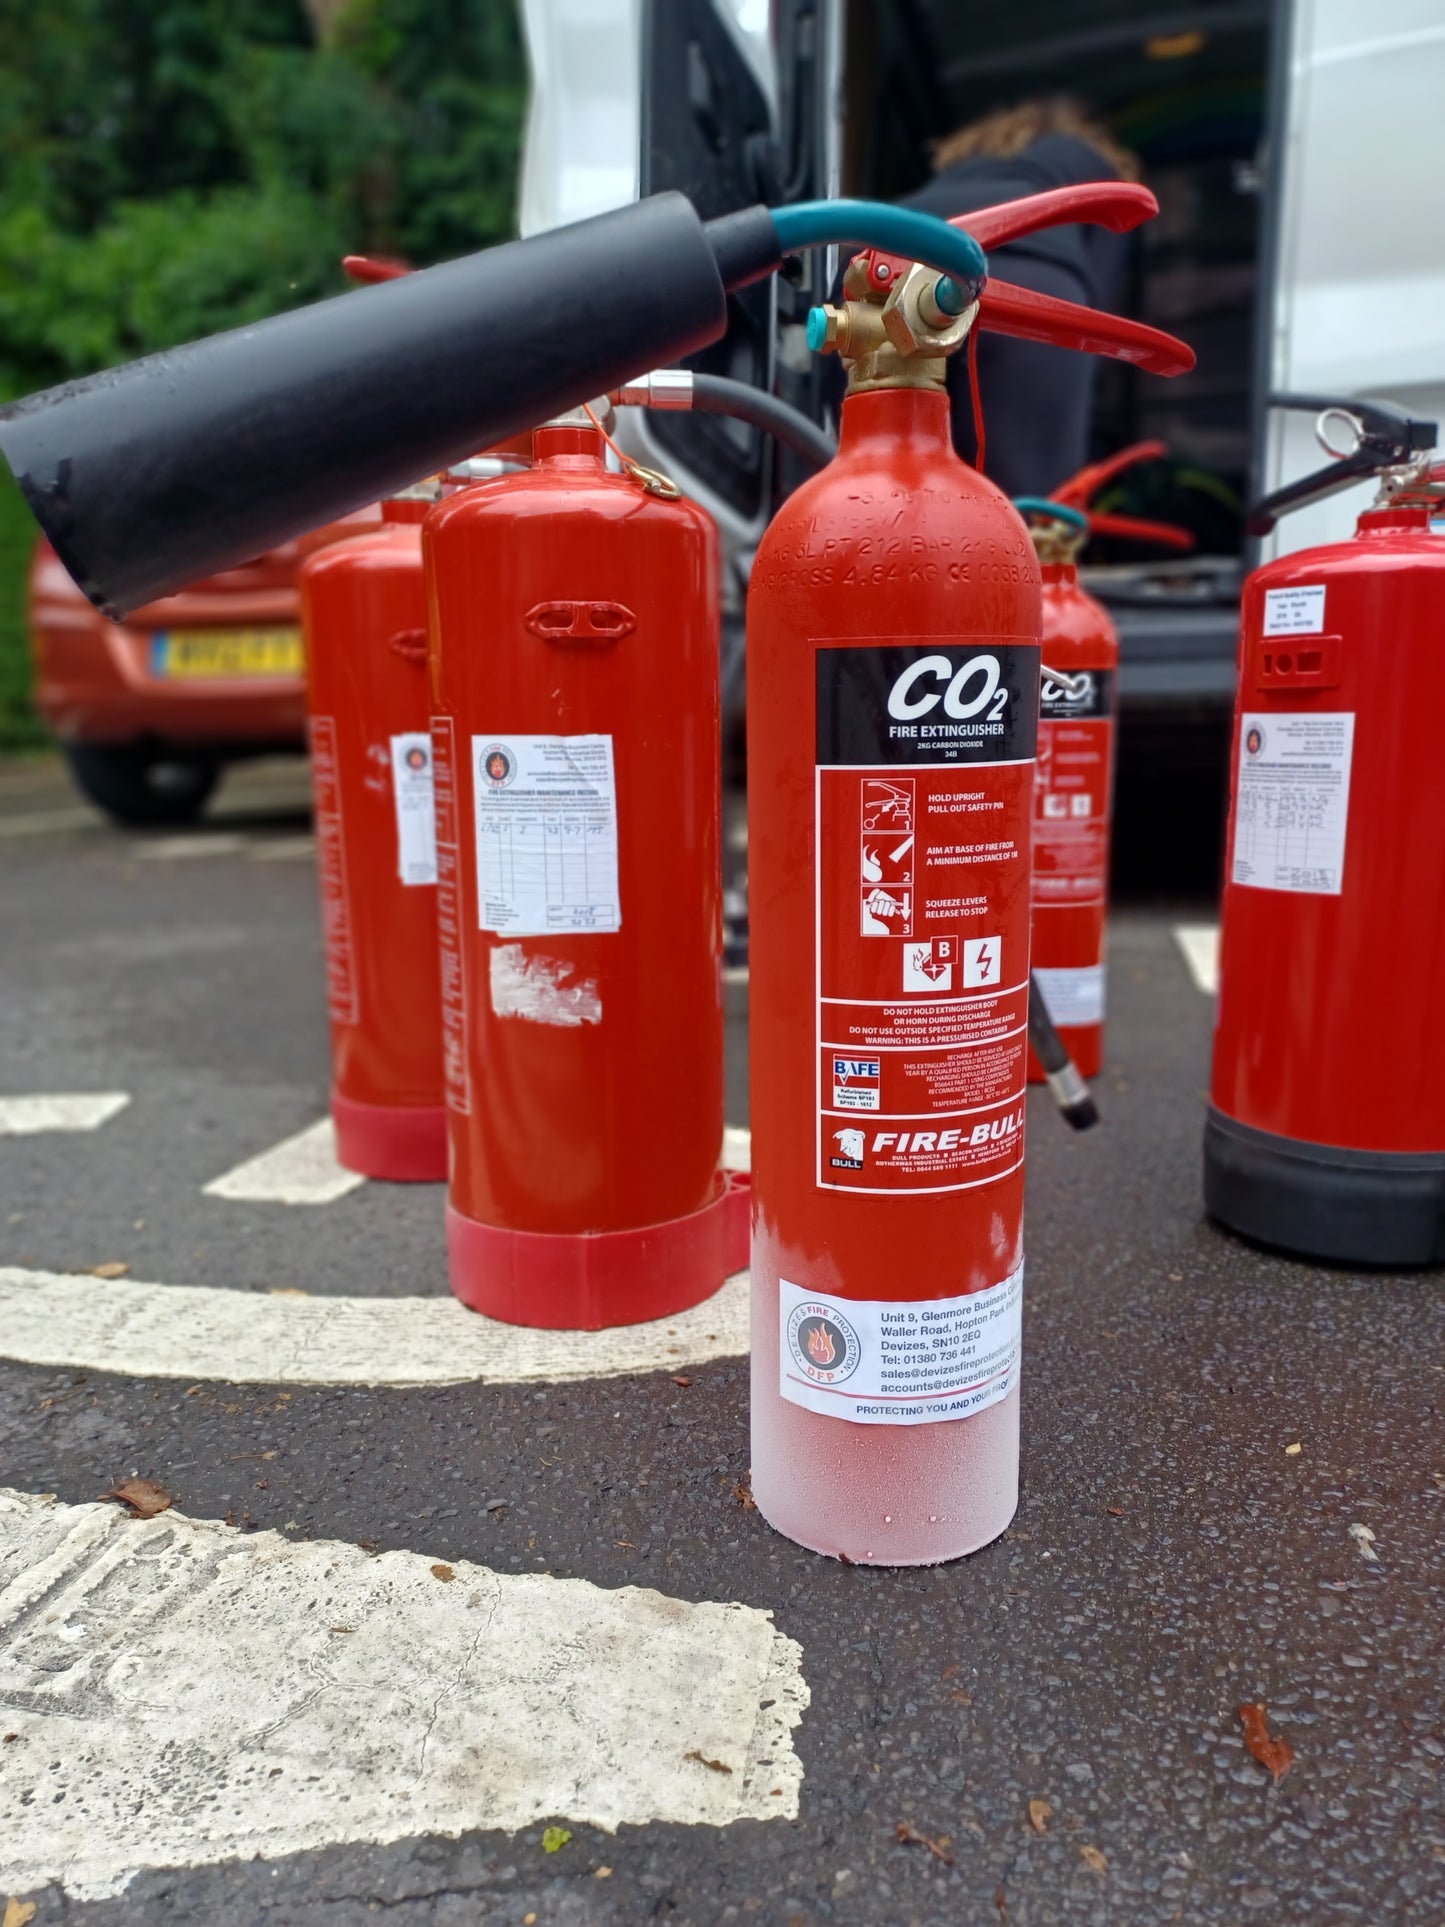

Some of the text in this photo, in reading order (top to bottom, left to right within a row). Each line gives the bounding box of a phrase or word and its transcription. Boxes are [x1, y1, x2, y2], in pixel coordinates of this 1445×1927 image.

[858, 536, 902, 556] 212
[910, 535, 953, 554] BAR
[842, 564, 898, 585] 4.84
[909, 562, 938, 583] KG
[948, 562, 970, 583] CE
[889, 723, 1005, 738] FIRE EXTINGUISHER
[917, 740, 984, 750] 2KG CARBON DIOXIDE
[928, 792, 985, 802] HOLD UPRIGHT
[928, 805, 949, 813] PULL
[950, 804, 966, 812] OUT
[967, 802, 993, 812] SAFETY
[904, 820, 910, 830] 1
[926, 841, 1014, 856] AIM AT BASE OF FIRE FROM
[926, 858, 933, 866] A
[934, 856, 971, 866] MINIMUM
[972, 852, 1003, 864] DISTANCE
[1003, 852, 1011, 861] OF
[903, 872, 911, 882] 2
[926, 896, 987, 908] SQUEEZE LEVERS
[926, 906, 988, 919] RELEASE TO STOP
[903, 924, 910, 934] 3
[938, 941, 951, 957] B
[884, 1000, 998, 1016] DO NOT HOLD EXTINGUISHER BODY
[849, 1012, 1016, 1035] DO NOT USE OUTSIDE SPECIFIED TEMPERATURE RANGE
[906, 1017, 928, 1025] HORN
[929, 1014, 957, 1024] DURING
[957, 1010, 991, 1022] DISCHARGE
[865, 1025, 1008, 1045] WARNING: THIS IS A PRESSURISED CONTAINER
[917, 1060, 956, 1070] EXTINGUISHER
[956, 1058, 977, 1066] SHOULD
[934, 1066, 961, 1075] QUALIFIED
[962, 1064, 981, 1072] PERSON
[961, 1070, 981, 1078] SHOULD
[928, 1085, 969, 1095] RECOMMENDED
[872, 1108, 1024, 1152] FIRE-BULL
[832, 1158, 861, 1168] BULL
[909, 1153, 940, 1161] PRODUCTS
[914, 1158, 947, 1167] INDUSTRIAL
[881, 1313, 905, 1323] Unit
[907, 1313, 918, 1324] 9,
[921, 1306, 972, 1322] Glenmore
[974, 1291, 1007, 1312] Business
[880, 1307, 1005, 1337] Waller Road, Hopton Park
[790, 1305, 857, 1373] DEVIZES FIRE PROTECTION
[881, 1329, 981, 1352] Devizes, SN10 2EQ
[881, 1345, 976, 1365] Tel: 01380 736 441
[807, 1366, 834, 1382] DFP
[856, 1389, 992, 1416] PROTECTING YOU AND YOUR
